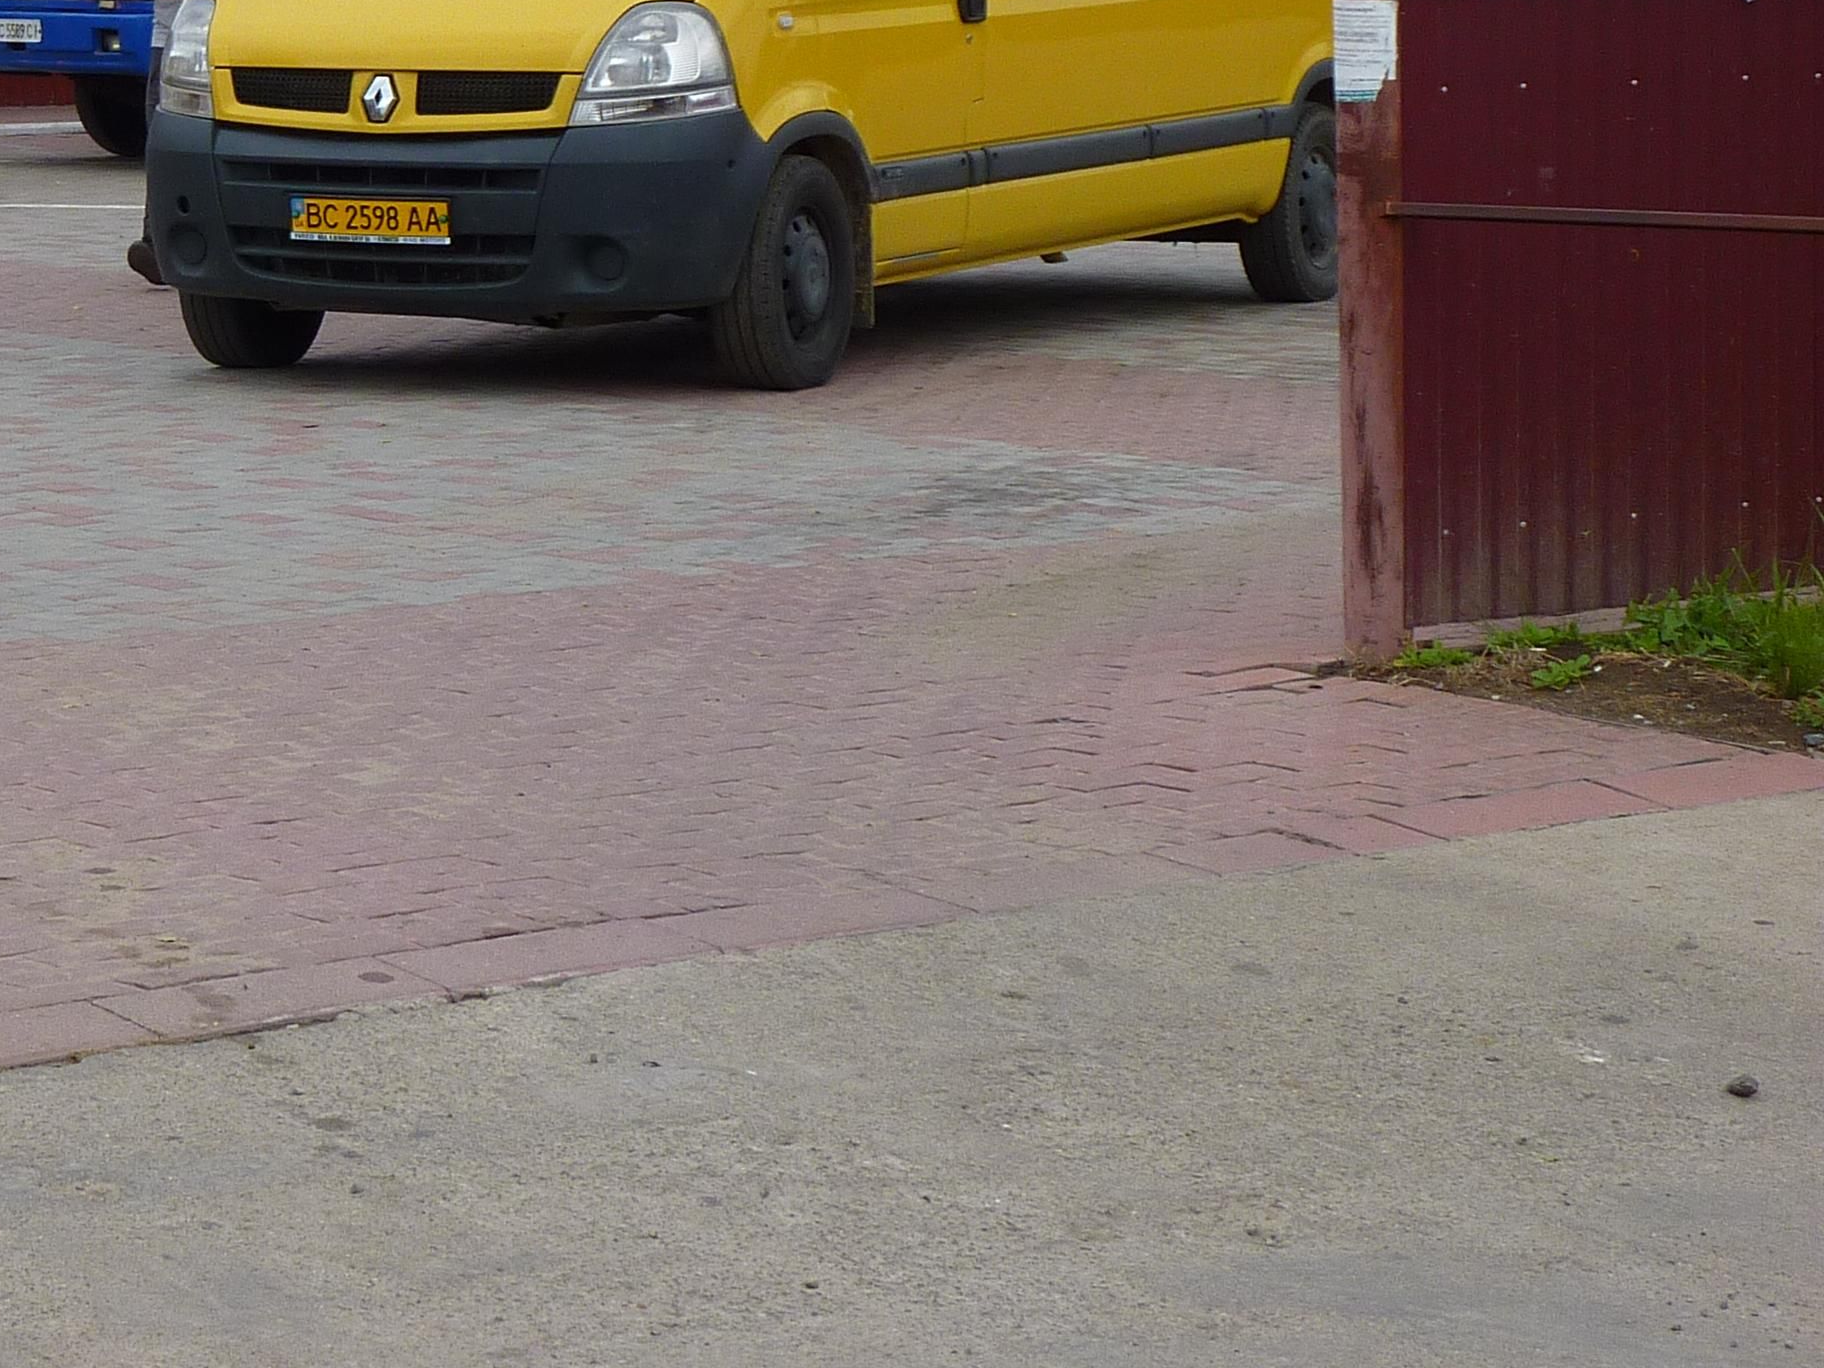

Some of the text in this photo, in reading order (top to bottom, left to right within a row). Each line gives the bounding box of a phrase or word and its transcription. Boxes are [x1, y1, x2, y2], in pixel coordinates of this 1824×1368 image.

[306, 203, 441, 232] BC 2598 AA
